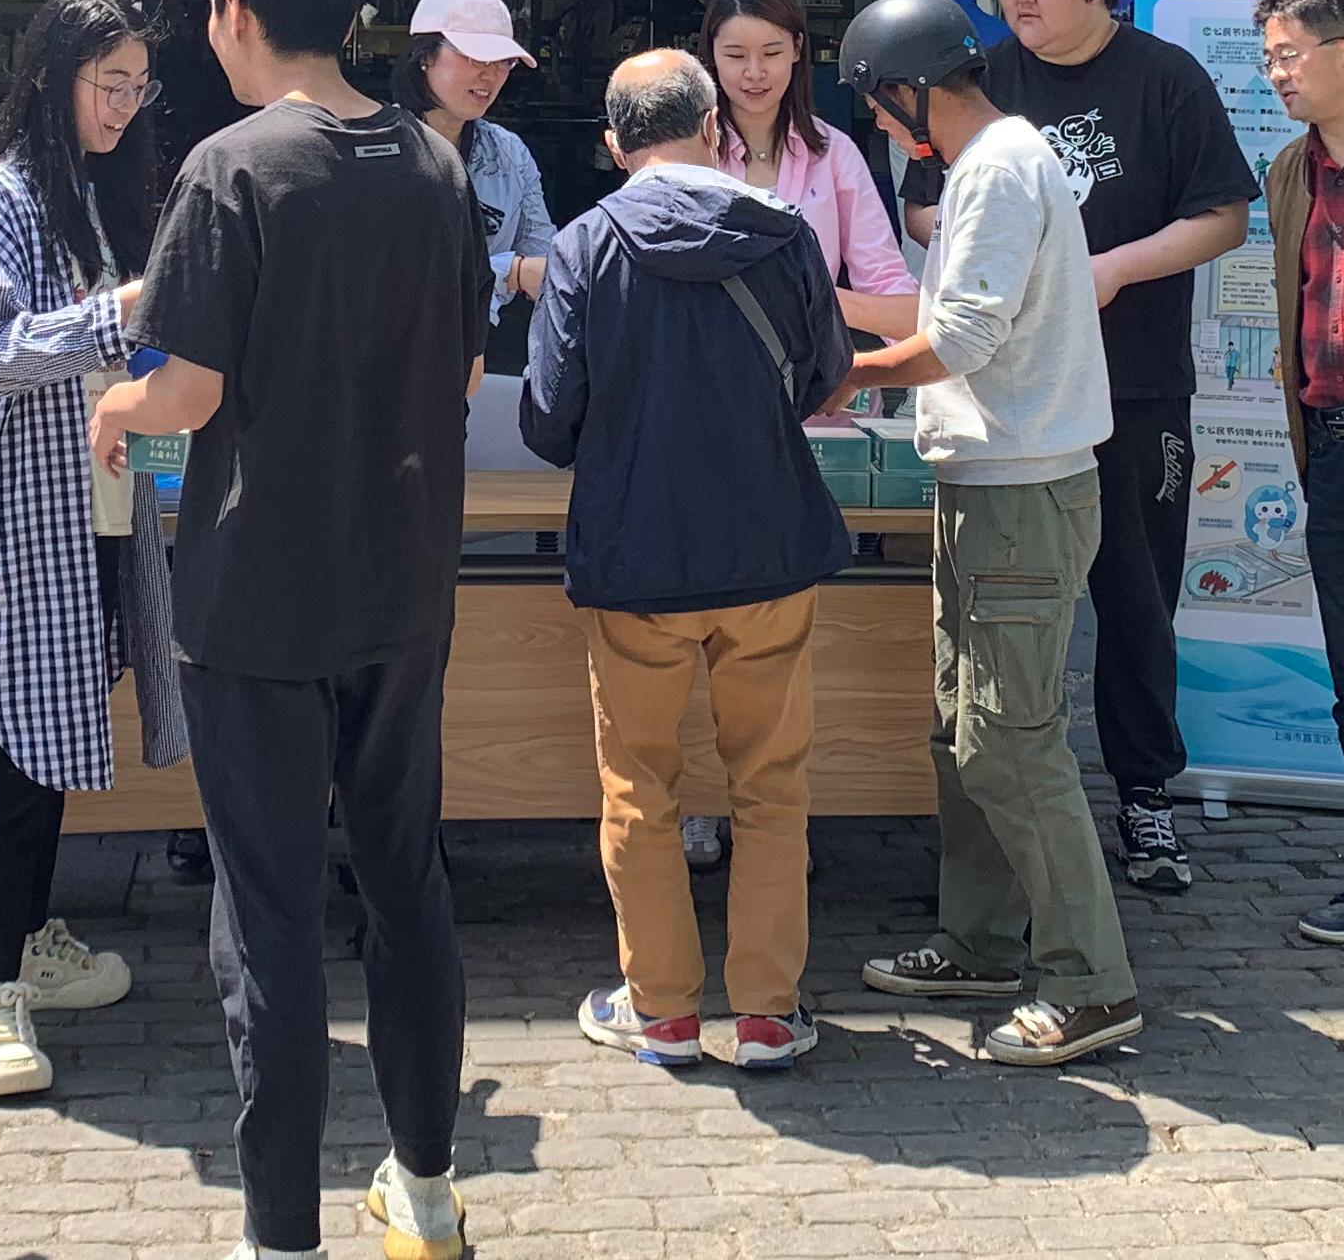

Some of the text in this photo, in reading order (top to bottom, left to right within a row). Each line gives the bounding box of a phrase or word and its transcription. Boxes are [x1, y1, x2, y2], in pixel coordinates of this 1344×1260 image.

[1272, 730, 1341, 746] 上海市嘉定区
